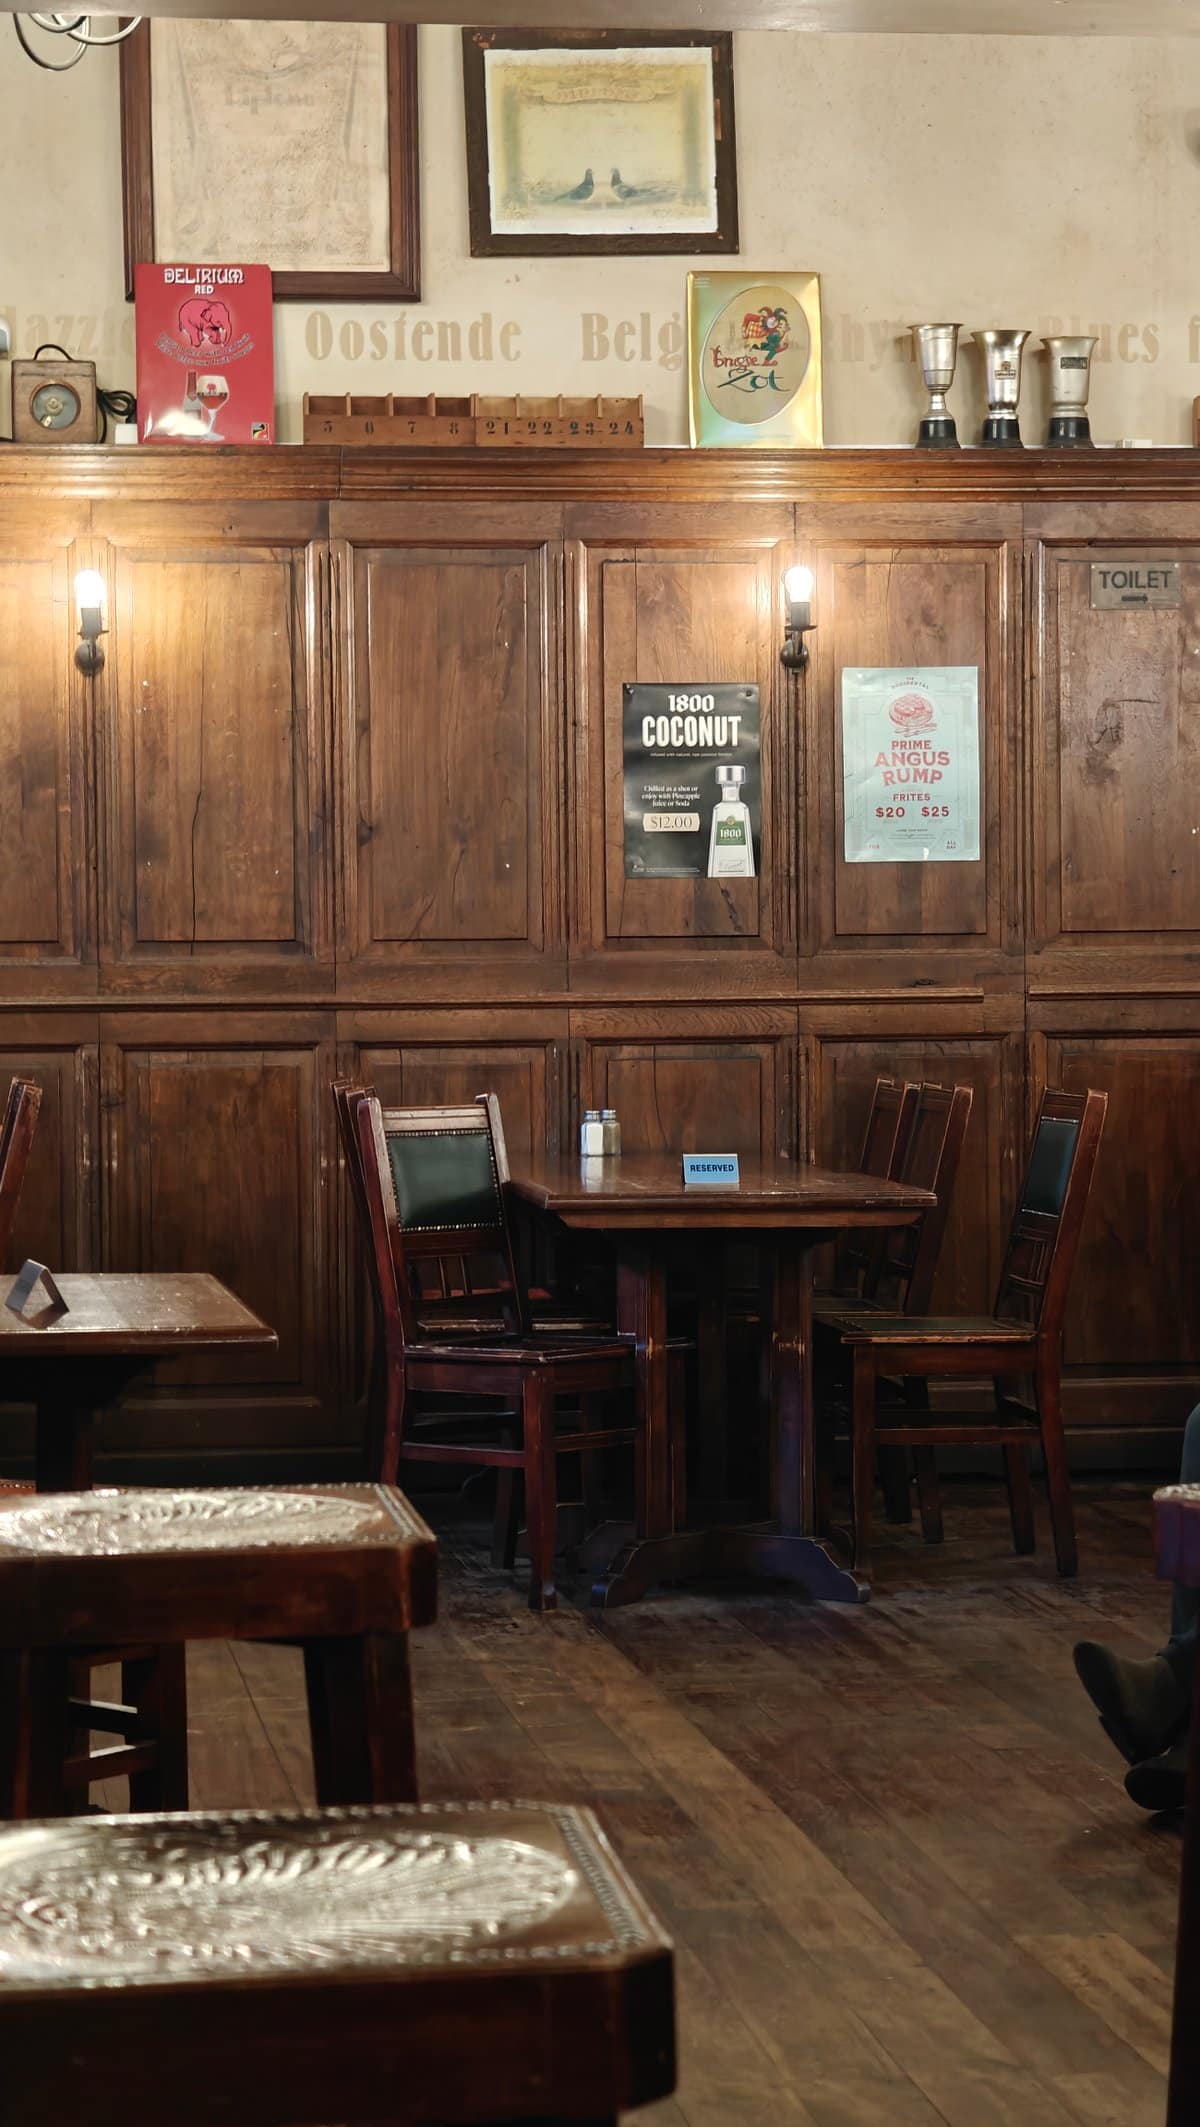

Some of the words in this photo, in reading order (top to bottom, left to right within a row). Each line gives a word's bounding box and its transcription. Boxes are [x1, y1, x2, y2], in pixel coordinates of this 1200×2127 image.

[164, 268, 243, 284] DELIRIUM
[194, 284, 214, 295] RED
[305, 310, 522, 361] Oostende
[581, 312, 684, 371] Belg
[710, 345, 758, 373] brugse
[717, 368, 790, 393] Zot
[323, 420, 333, 433] 5
[407, 420, 416, 434] 7
[449, 421, 459, 434] 8
[1098, 570, 1173, 589] TOILET
[668, 694, 715, 712] 1800
[642, 715, 742, 747] COCONUT
[891, 740, 932, 750] PRIME
[874, 751, 950, 767] ANGUS
[882, 768, 943, 786] RUMP
[875, 806, 906, 818] $20
[921, 806, 950, 817] $25
[650, 816, 693, 829] $12.00
[720, 829, 741, 838] 1800
[690, 1164, 734, 1172] RESERVED
